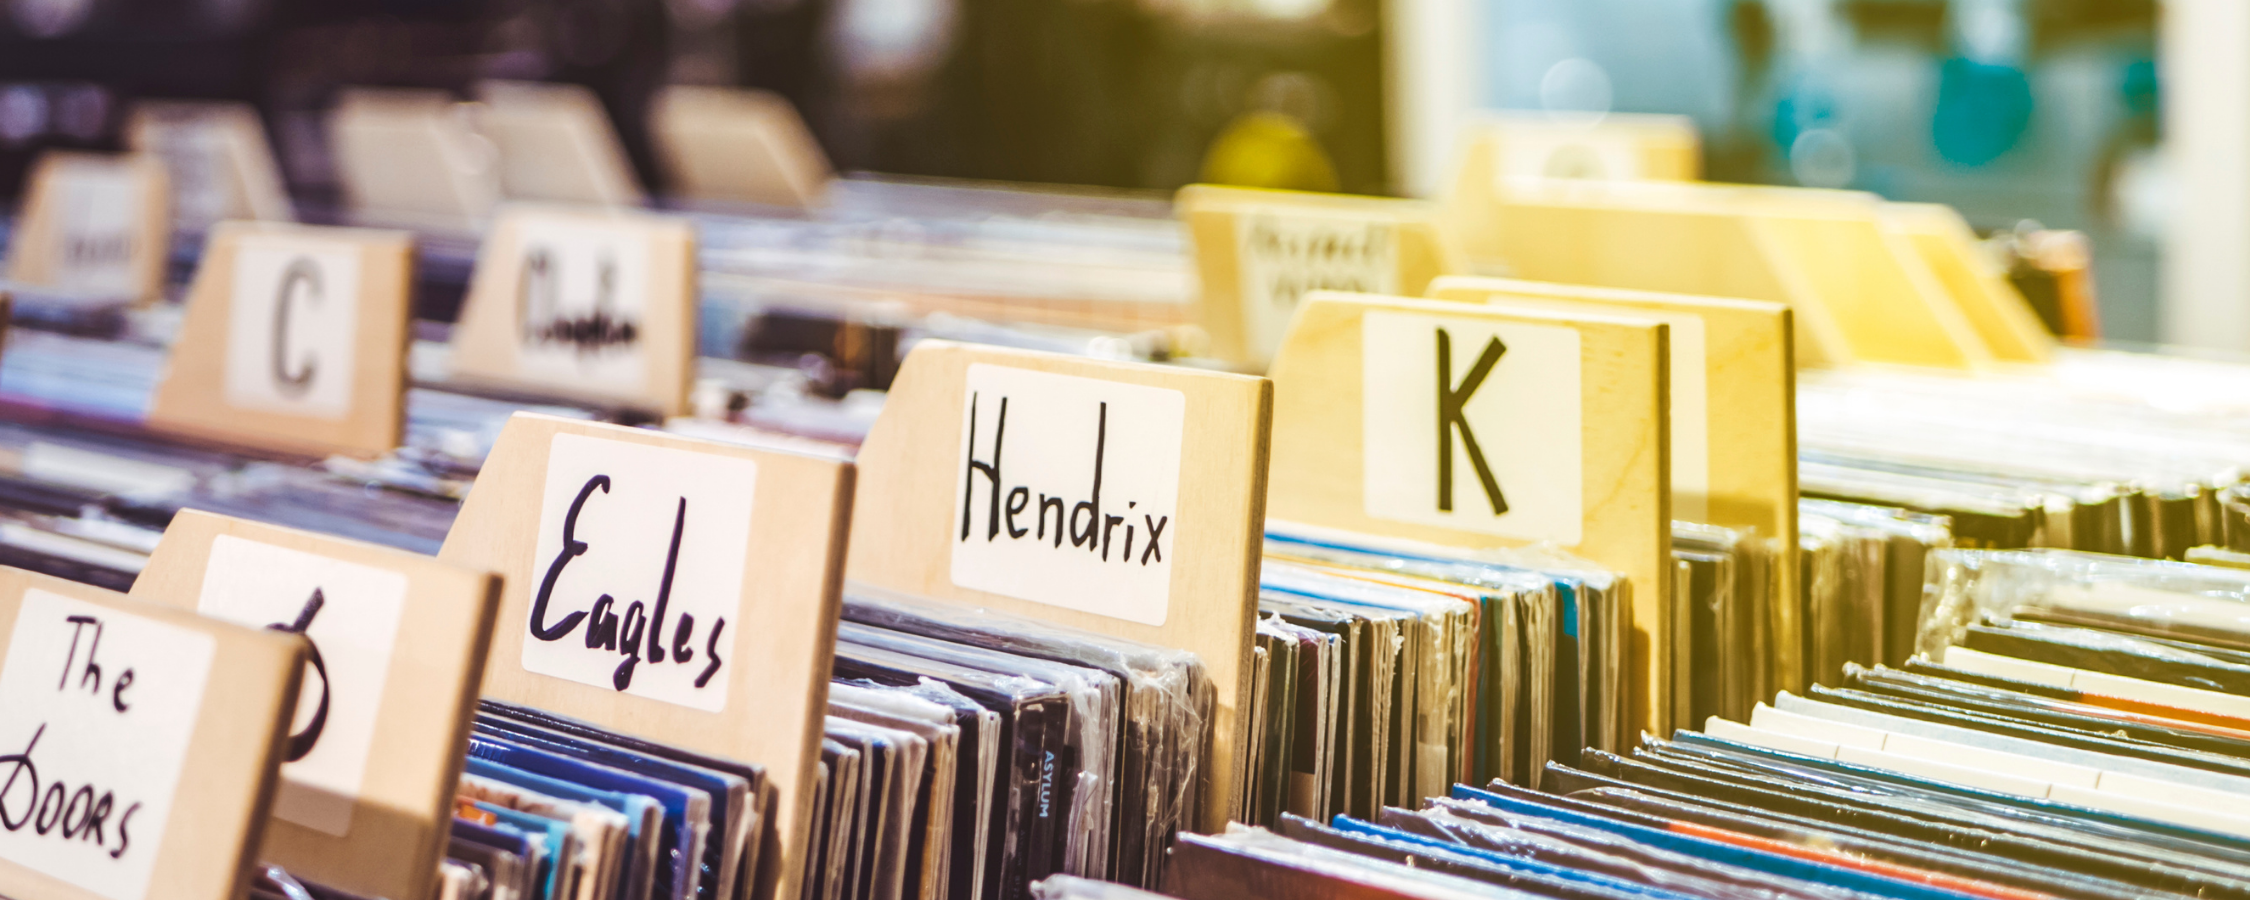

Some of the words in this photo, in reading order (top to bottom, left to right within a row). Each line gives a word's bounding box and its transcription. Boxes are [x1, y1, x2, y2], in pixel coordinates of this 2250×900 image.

[271, 257, 324, 400] C
[961, 390, 1169, 567] Hendrix
[1436, 328, 1510, 516] K
[529, 474, 726, 692] Eagles
[59, 614, 135, 713] The
[1038, 750, 1055, 818] ASYLUM
